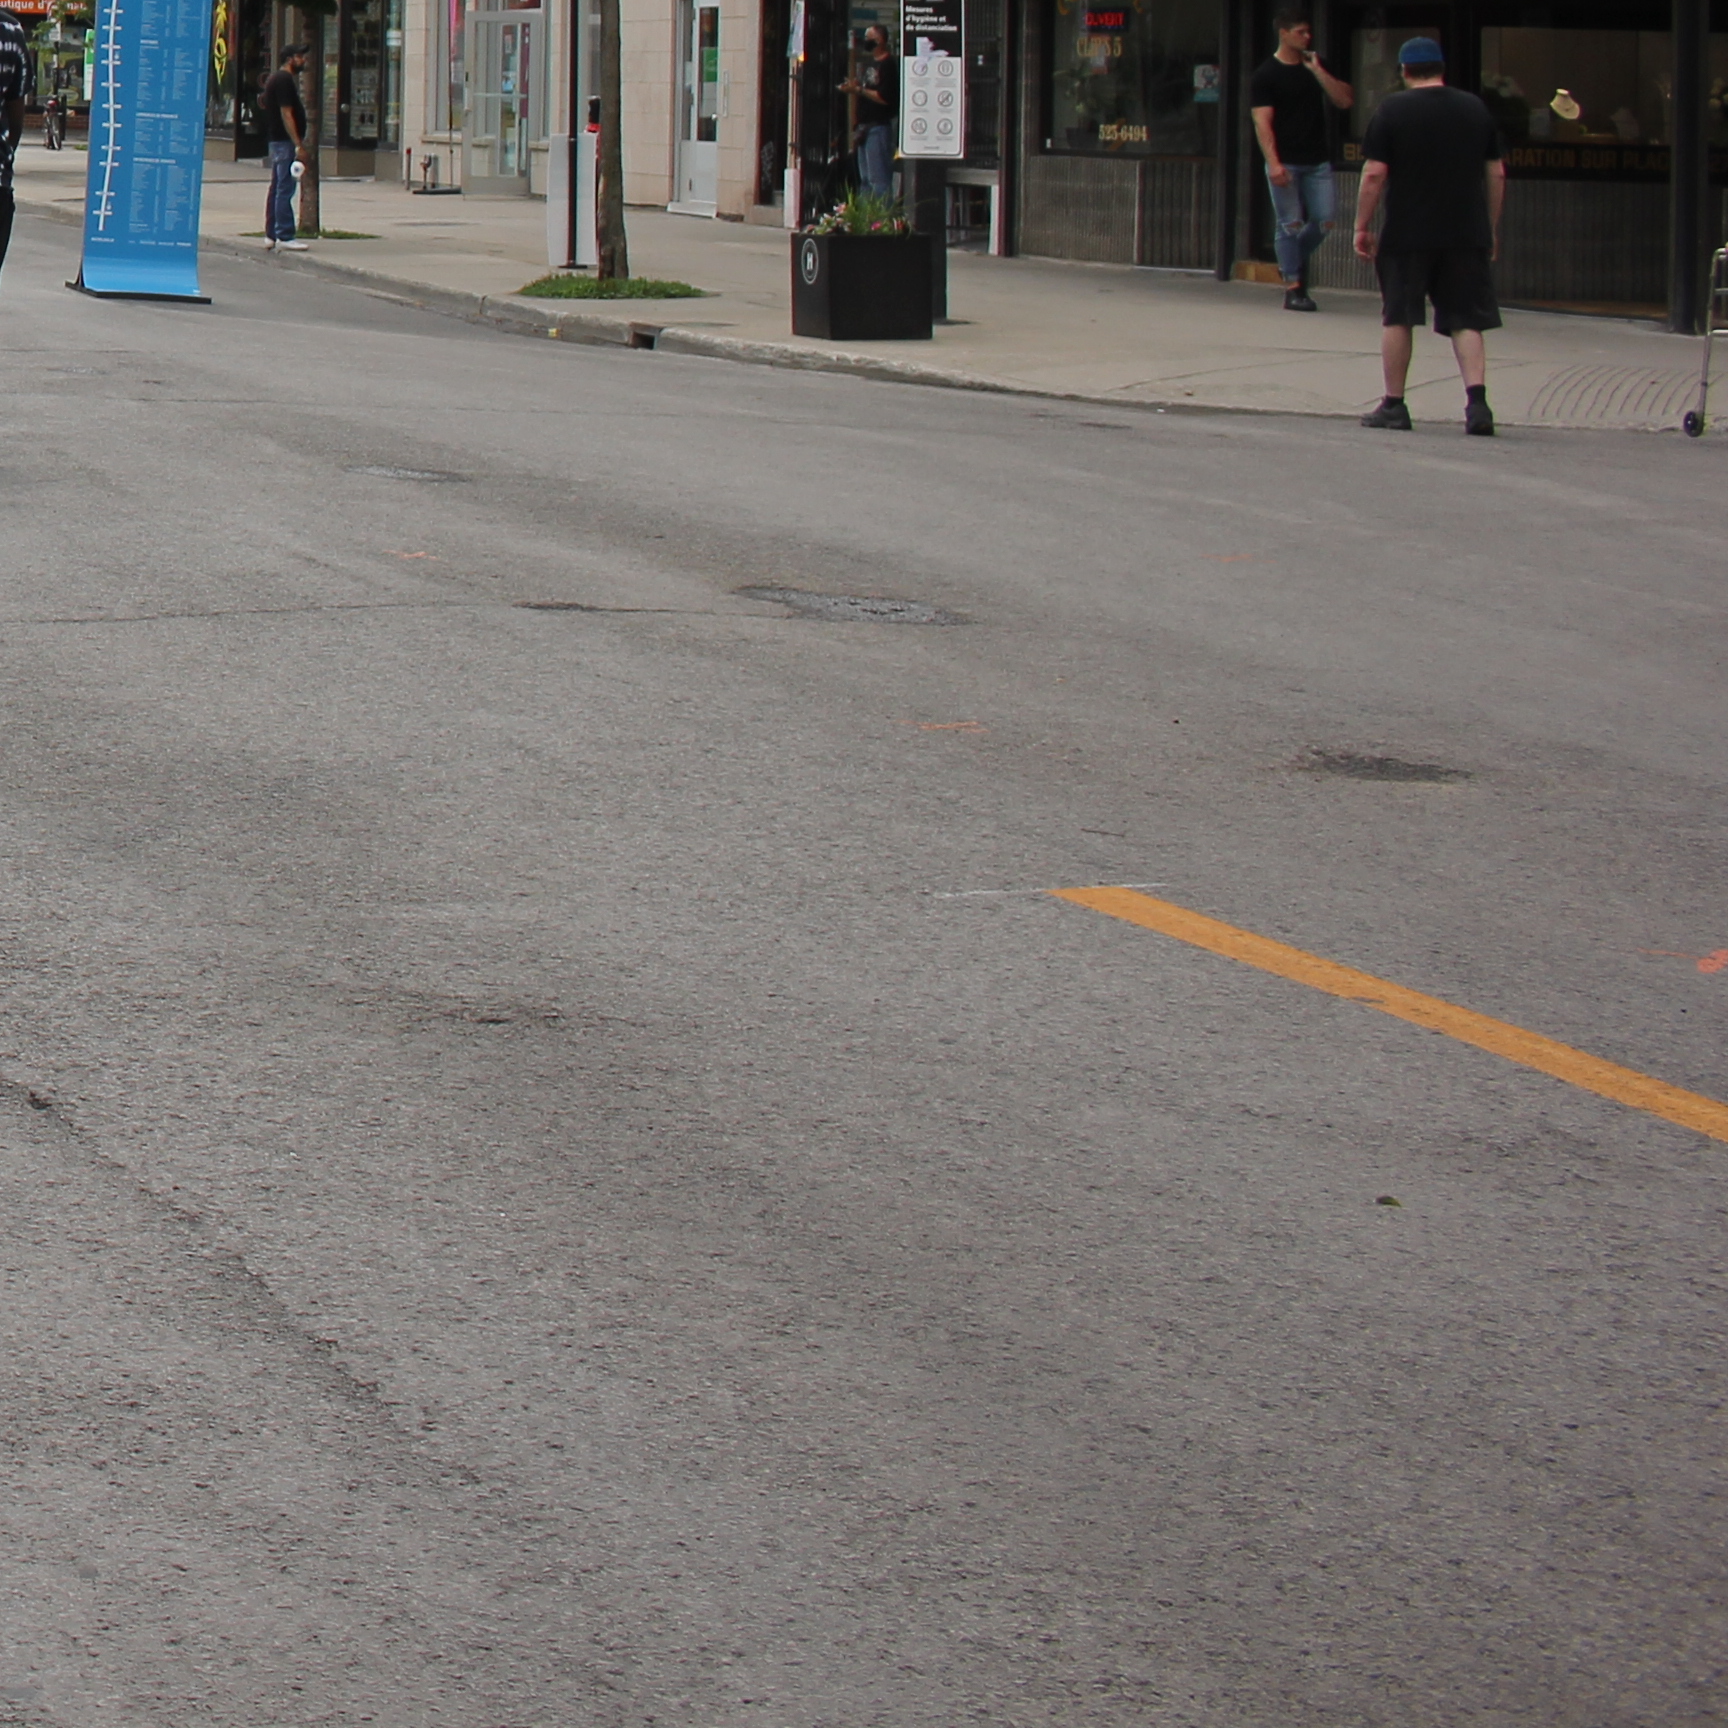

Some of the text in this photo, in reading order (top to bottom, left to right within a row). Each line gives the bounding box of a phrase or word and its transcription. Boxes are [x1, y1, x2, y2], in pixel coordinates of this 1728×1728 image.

[905, 5, 934, 13] Mesures
[905, 14, 938, 24] d'hygiène
[905, 23, 958, 32] de distanciation
